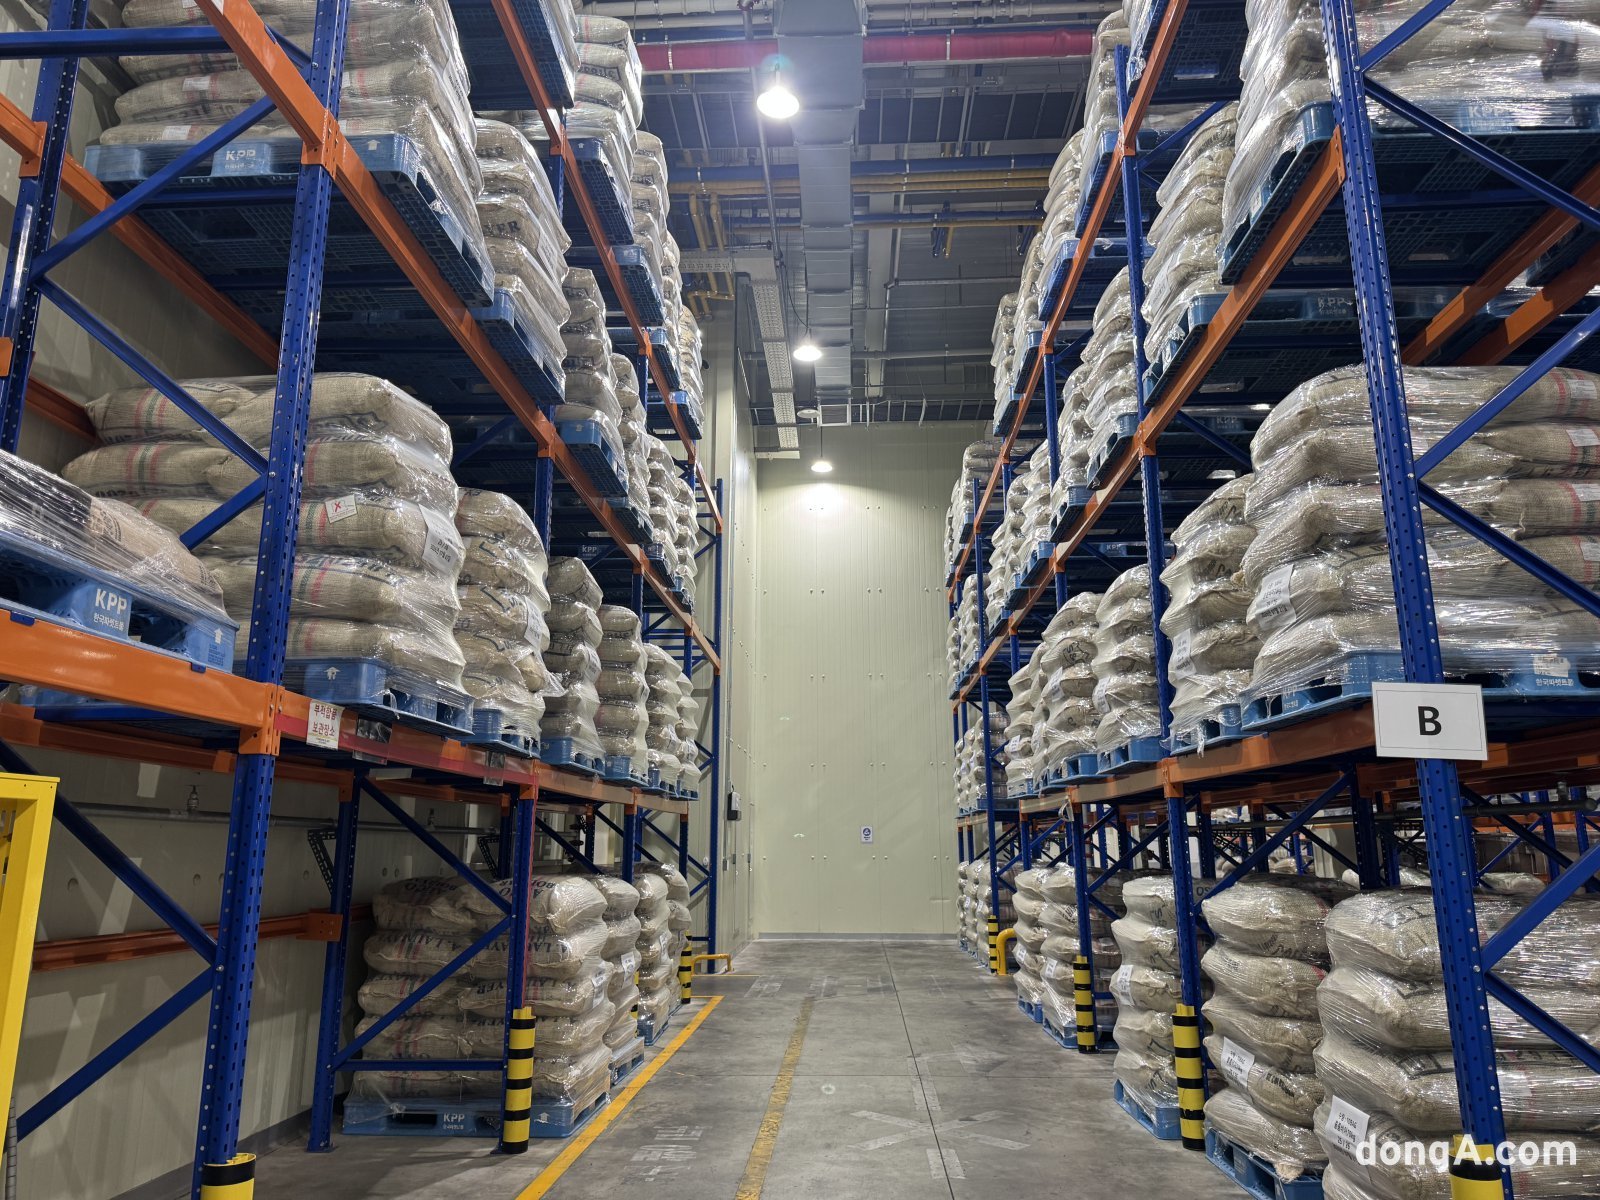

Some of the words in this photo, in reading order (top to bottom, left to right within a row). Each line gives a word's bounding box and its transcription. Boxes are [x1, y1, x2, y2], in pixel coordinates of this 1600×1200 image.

[582, 545, 597, 553] KPP
[94, 588, 128, 614] KPP
[314, 703, 338, 721] 부적합품
[1417, 705, 1442, 736] B
[312, 721, 335, 737] 보관장소
[443, 1112, 465, 1122] KPP
